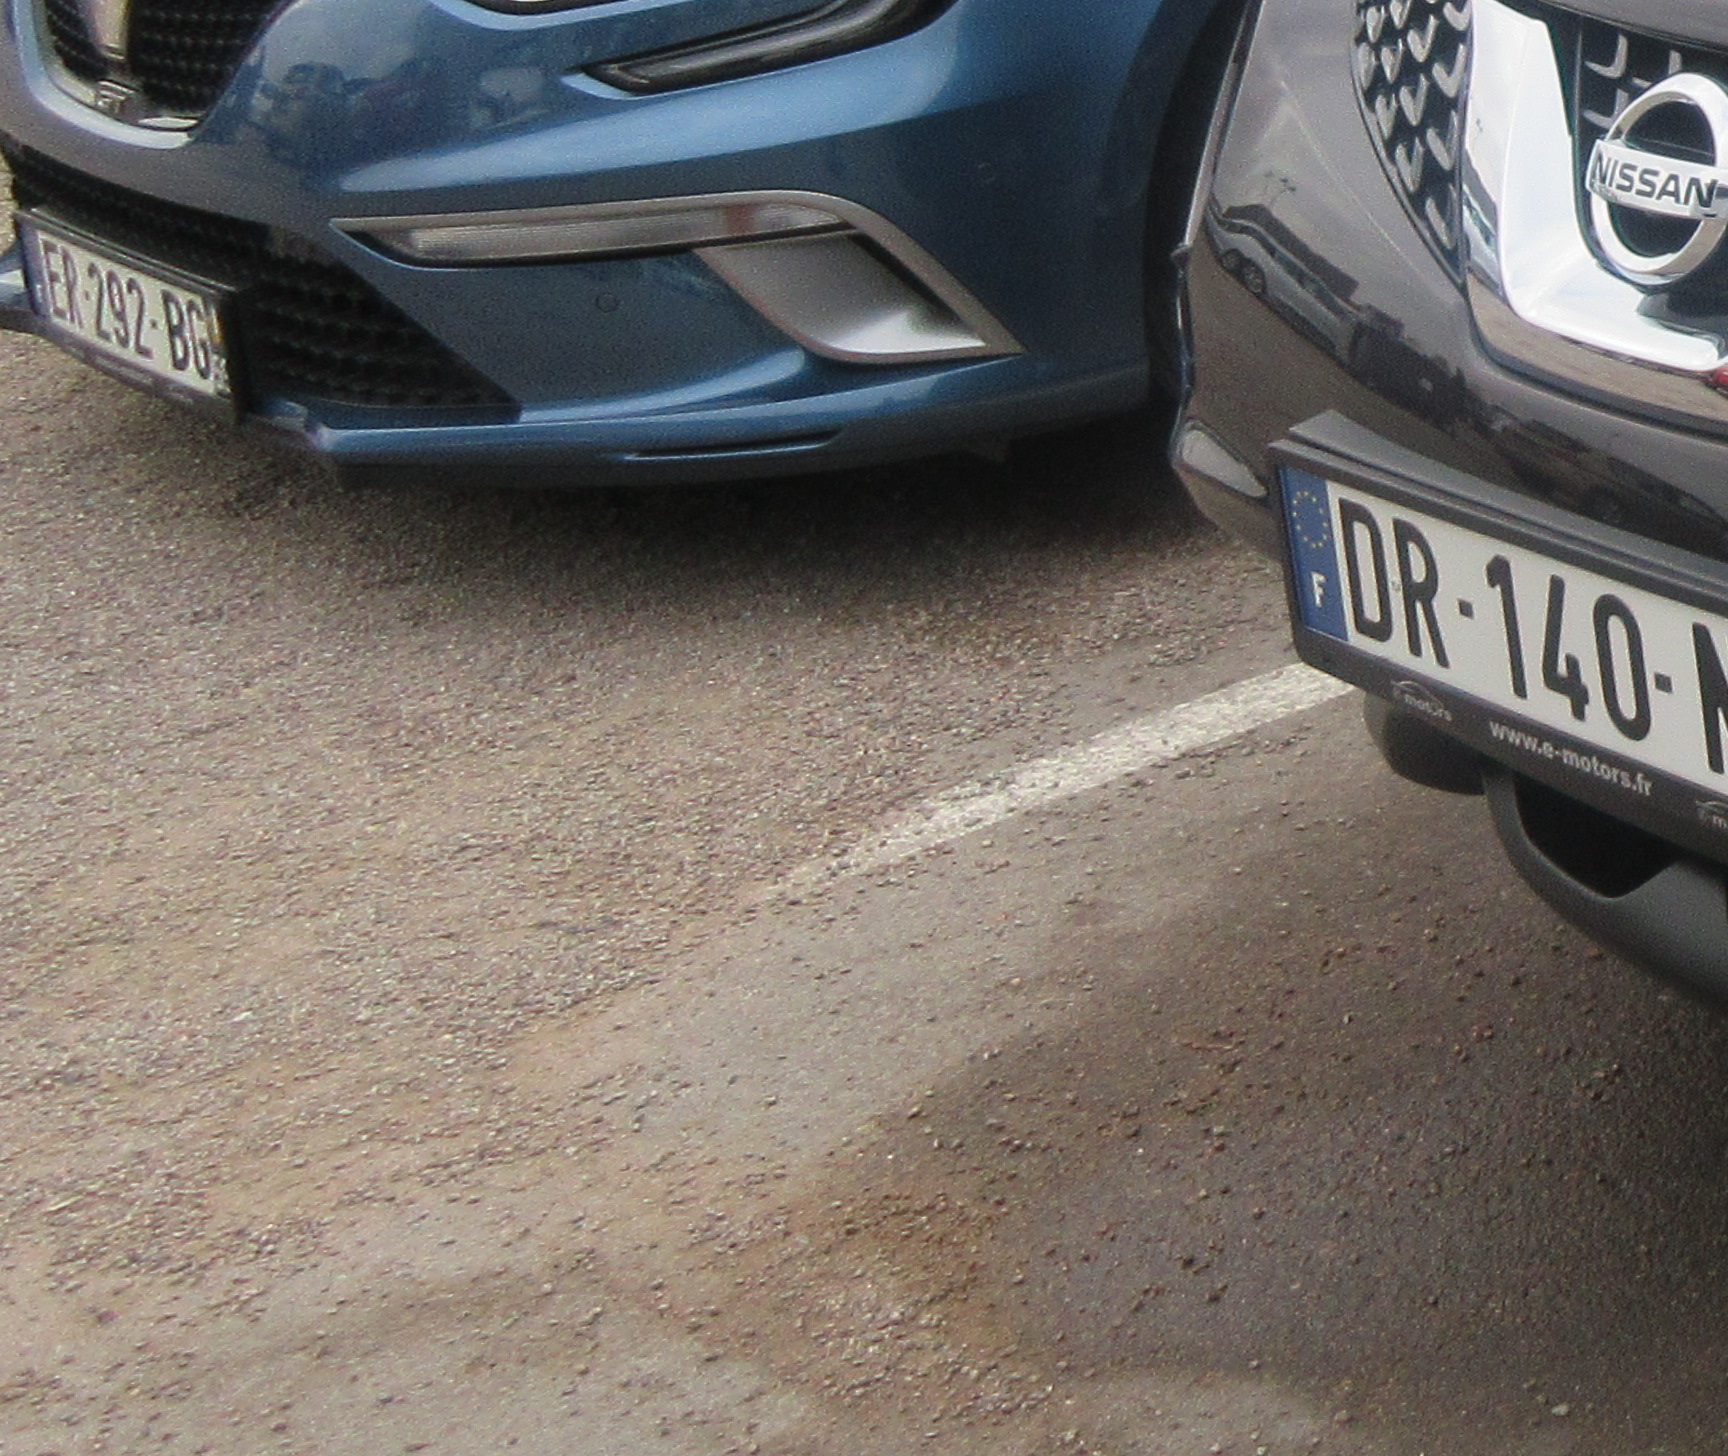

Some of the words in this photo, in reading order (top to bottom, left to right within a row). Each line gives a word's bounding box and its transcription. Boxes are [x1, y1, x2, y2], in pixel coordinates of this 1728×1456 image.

[1593, 151, 1718, 208] NISSAN
[1310, 571, 1327, 608] F
[1489, 720, 1654, 796] www.e-motors.fr
